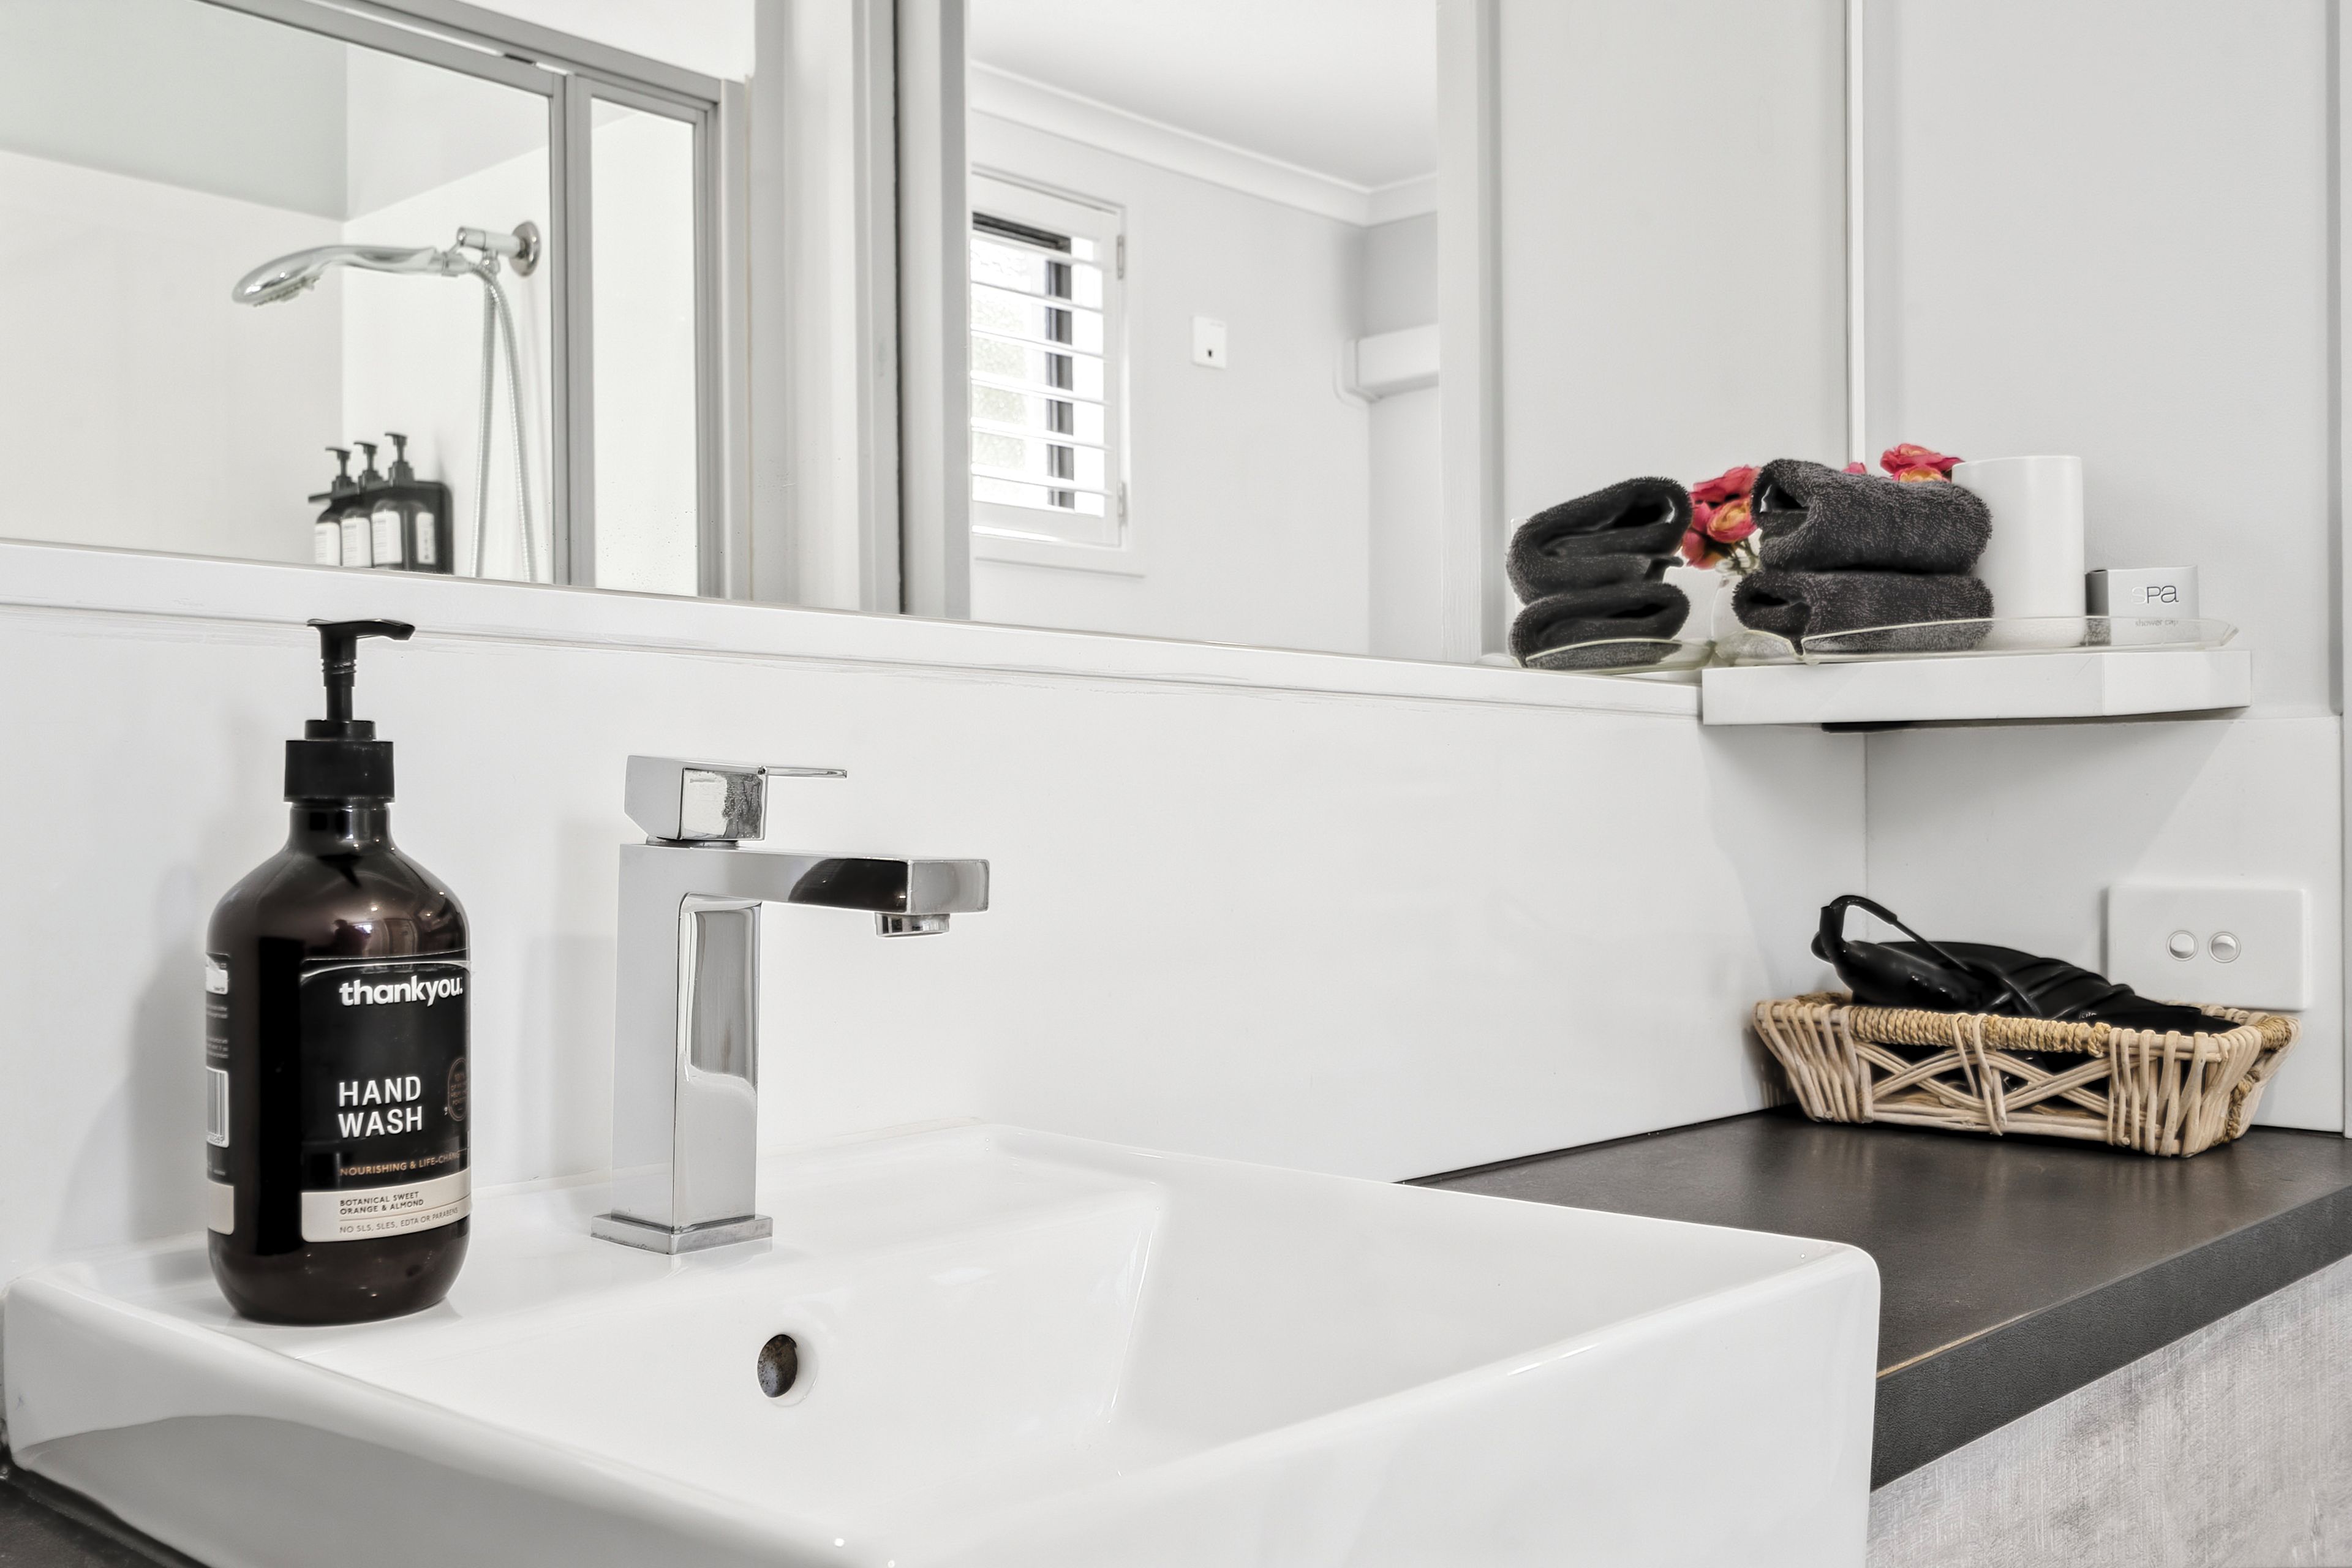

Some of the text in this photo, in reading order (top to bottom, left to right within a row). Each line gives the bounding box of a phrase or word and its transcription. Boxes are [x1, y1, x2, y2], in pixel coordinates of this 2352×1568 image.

[339, 1076, 422, 1107] HAND
[338, 1106, 423, 1139] WASH
[339, 1161, 407, 1177] NOURISHING
[410, 1161, 417, 1170] &
[340, 1191, 420, 1207] BOTANICAL SWEET
[340, 1205, 379, 1215] ORANGE
[390, 1199, 424, 1211] ALMOND
[339, 1225, 354, 1234] NO
[376, 1221, 398, 1230] SLES,
[401, 1218, 420, 1227] EDTA
[420, 1215, 431, 1224] OR
[432, 1207, 459, 1221] PARABENS
